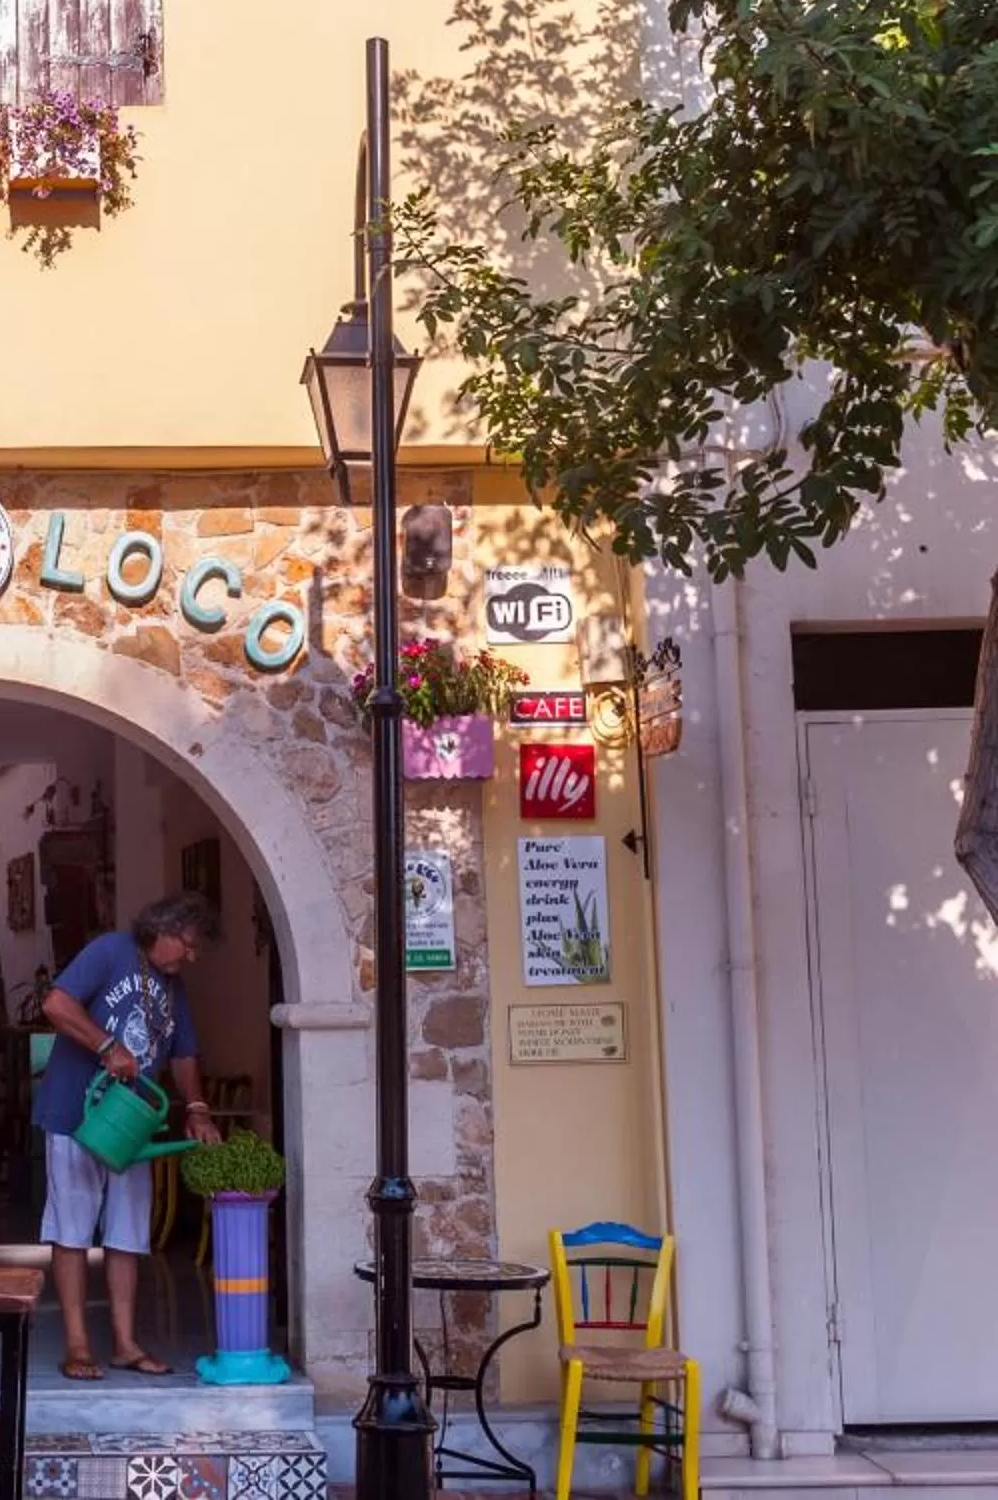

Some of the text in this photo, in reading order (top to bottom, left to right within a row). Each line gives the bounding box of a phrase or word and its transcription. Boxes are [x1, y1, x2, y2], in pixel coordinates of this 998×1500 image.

[40, 512, 305, 672] LOCO
[513, 697, 584, 719] CAFE
[525, 755, 590, 812] illy
[525, 841, 562, 853] Pure
[524, 858, 599, 870] Aloe Vera
[525, 879, 579, 891] energy
[525, 894, 570, 905] drink
[526, 911, 559, 926] plus
[527, 929, 601, 941] Aloe Vera
[527, 948, 562, 959] skin
[529, 963, 606, 976] treatment
[105, 973, 162, 1009] NEW YRK
